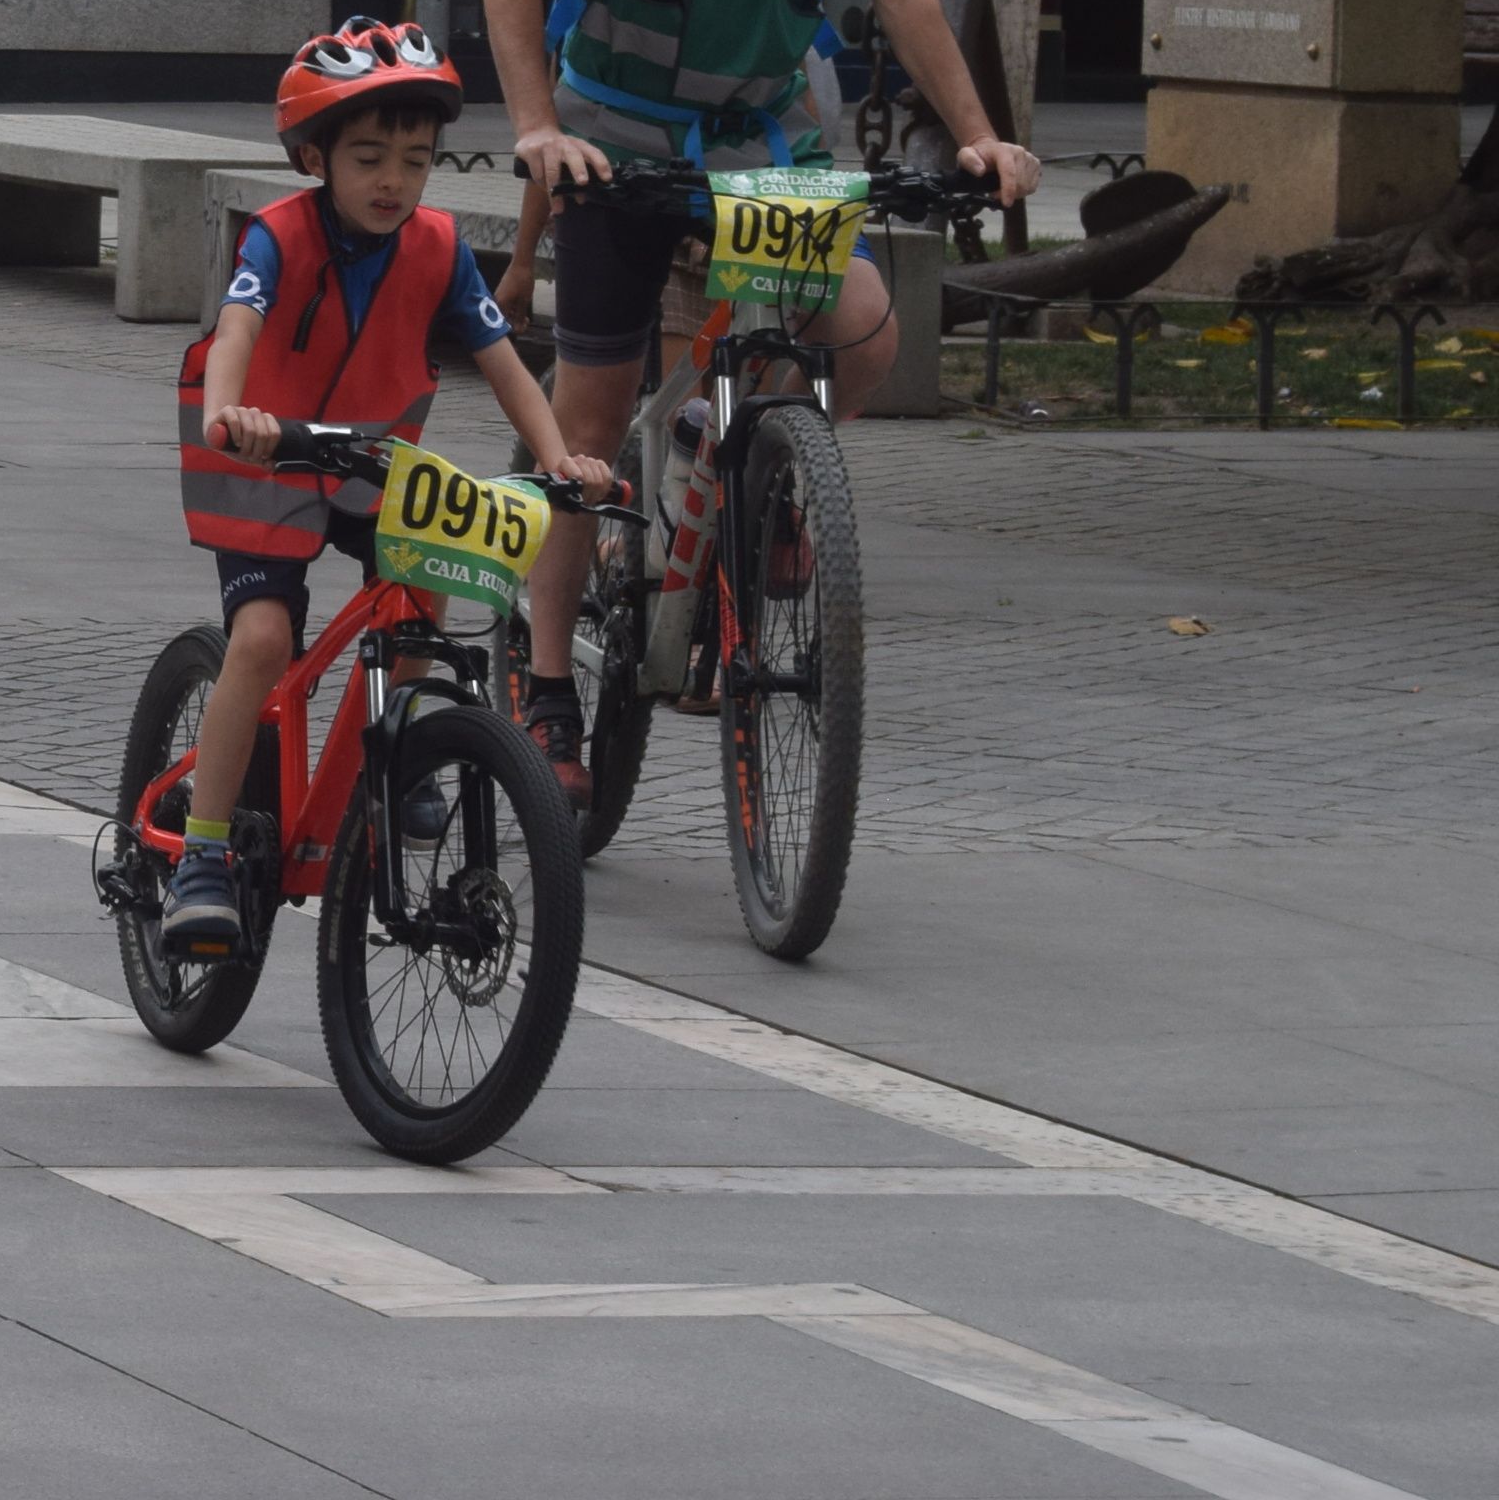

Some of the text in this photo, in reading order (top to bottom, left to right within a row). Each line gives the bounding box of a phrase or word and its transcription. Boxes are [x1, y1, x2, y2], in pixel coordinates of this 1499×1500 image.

[760, 183, 850, 198] CAJA RURAL
[732, 202, 842, 264] 0914
[752, 276, 791, 293] CAJA
[401, 463, 527, 558] 0915
[223, 571, 266, 600] ANYON
[424, 557, 514, 598] CAJA RURA
[124, 911, 151, 990] KENDA
